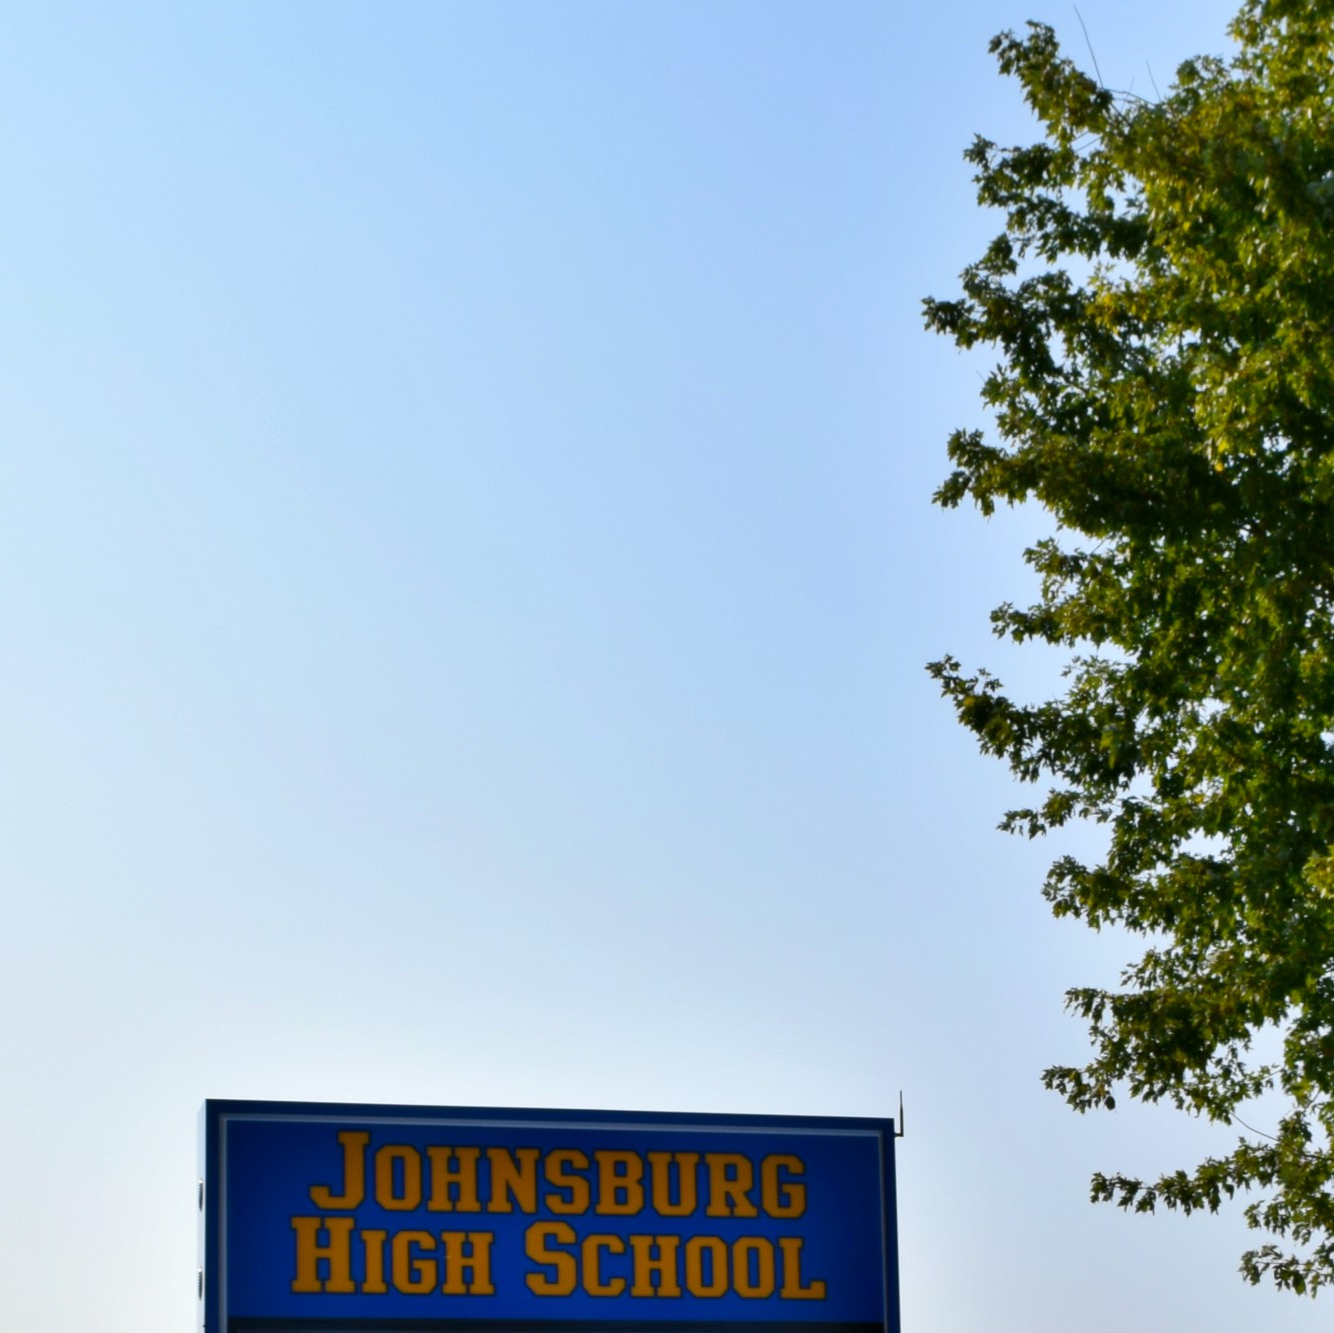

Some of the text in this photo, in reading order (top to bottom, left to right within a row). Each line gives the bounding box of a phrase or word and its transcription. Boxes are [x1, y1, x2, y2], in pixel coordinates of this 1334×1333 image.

[310, 1131, 806, 1219] JOHNSBURG
[291, 1216, 826, 1299] HIGH SCHOOL
